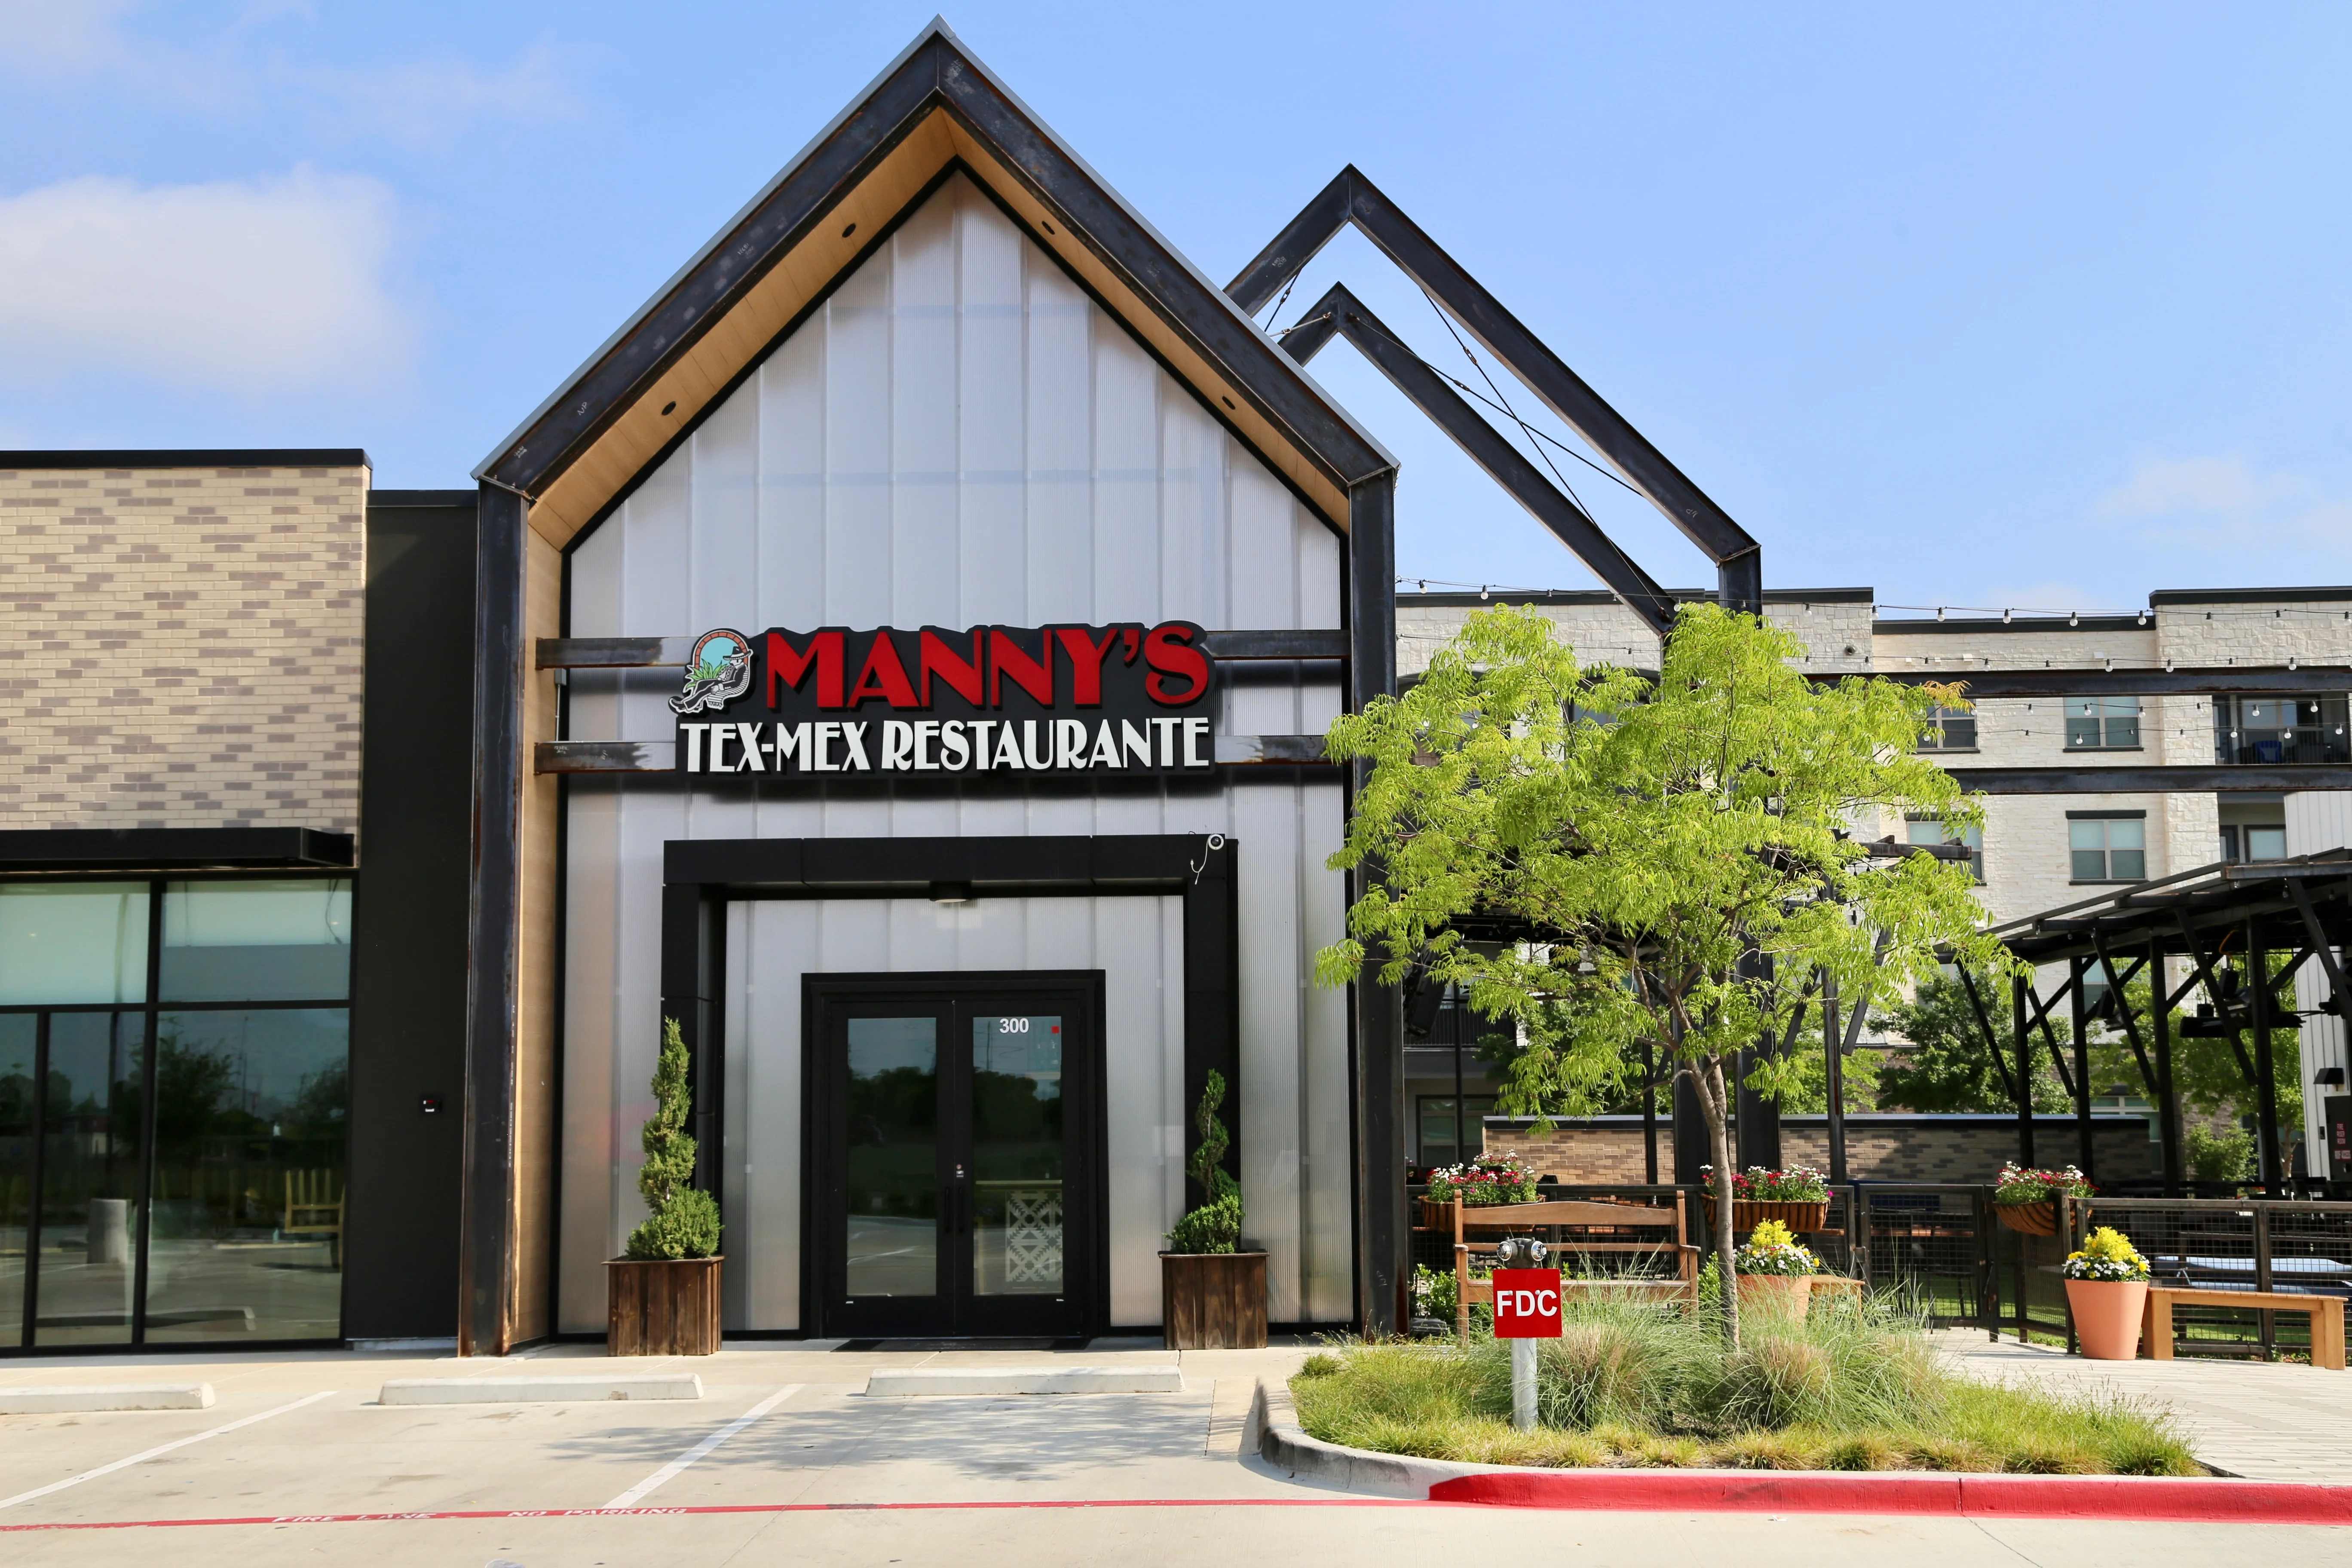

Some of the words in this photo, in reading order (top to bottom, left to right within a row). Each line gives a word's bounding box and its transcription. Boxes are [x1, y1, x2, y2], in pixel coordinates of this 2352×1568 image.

[767, 625, 1209, 708] MANNY'S
[680, 720, 868, 772] TEX-MEX
[882, 717, 1209, 771] RESTAURANTE
[999, 1018, 1029, 1033] 300
[1497, 1289, 1557, 1317] FDC
